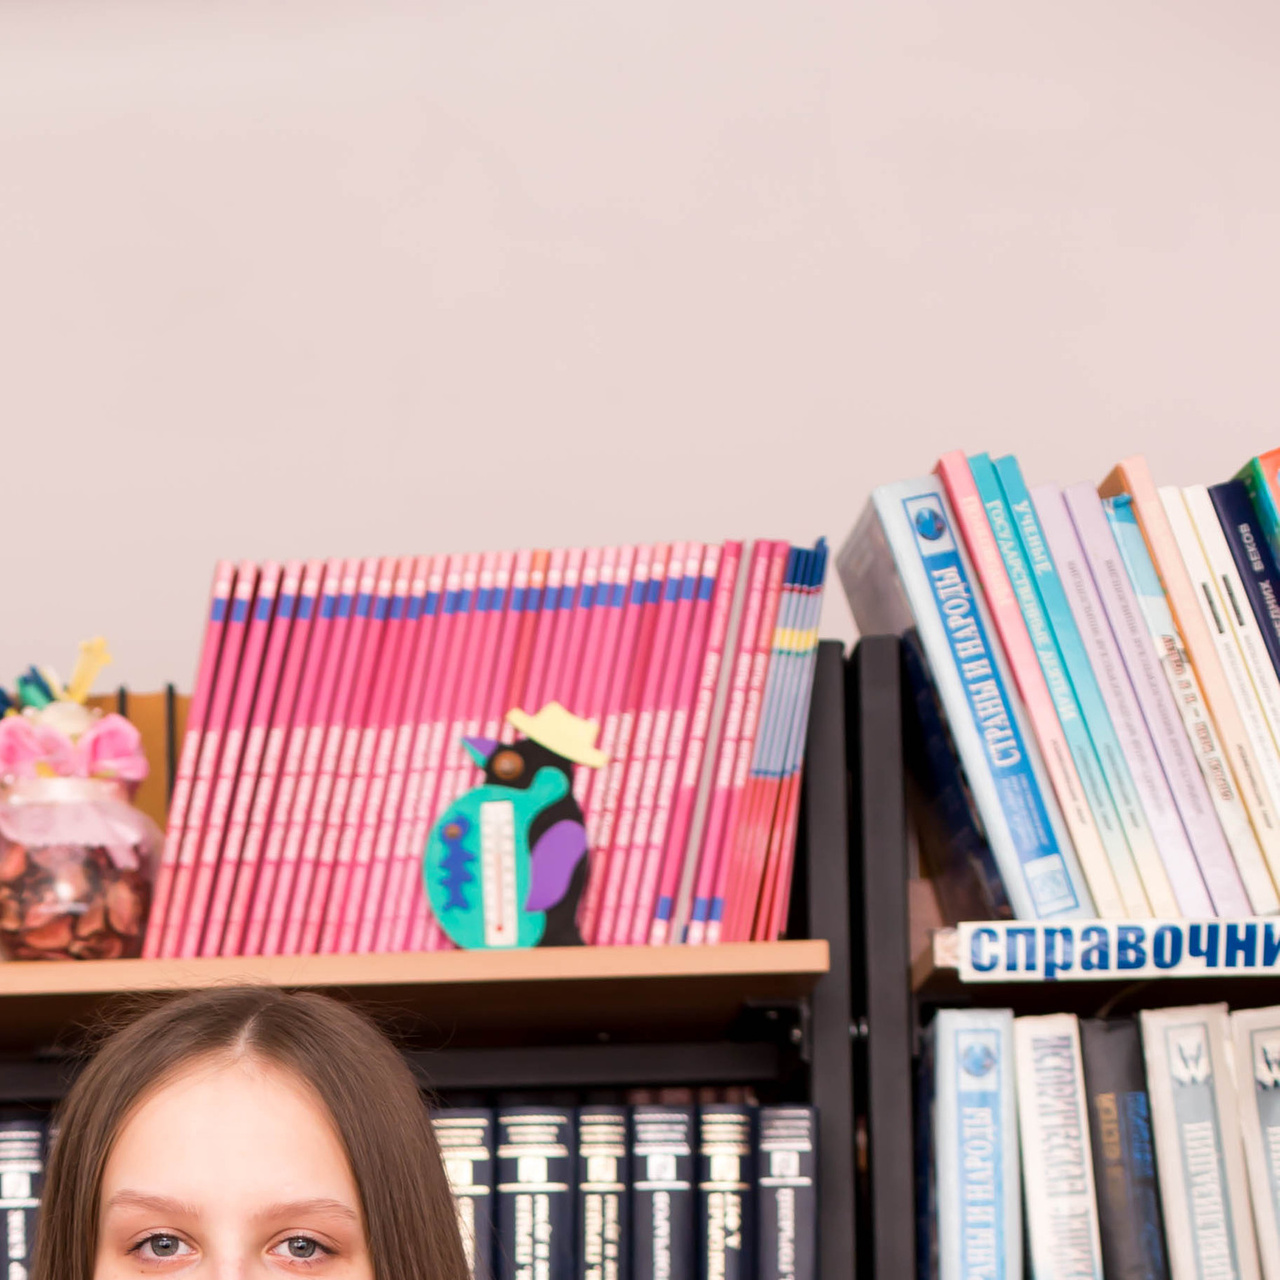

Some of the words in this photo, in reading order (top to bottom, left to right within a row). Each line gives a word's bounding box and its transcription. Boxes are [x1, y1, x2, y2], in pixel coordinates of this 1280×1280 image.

[1013, 499, 1052, 576] УЧЕНЫЕ
[1236, 522, 1264, 572] ВЕКОВ
[931, 563, 986, 660] НАРОДЫ
[962, 657, 992, 680] И
[968, 679, 1023, 770] СТРАНЫ
[963, 1107, 997, 1200] НАРОДЫ
[964, 1207, 996, 1222] И
